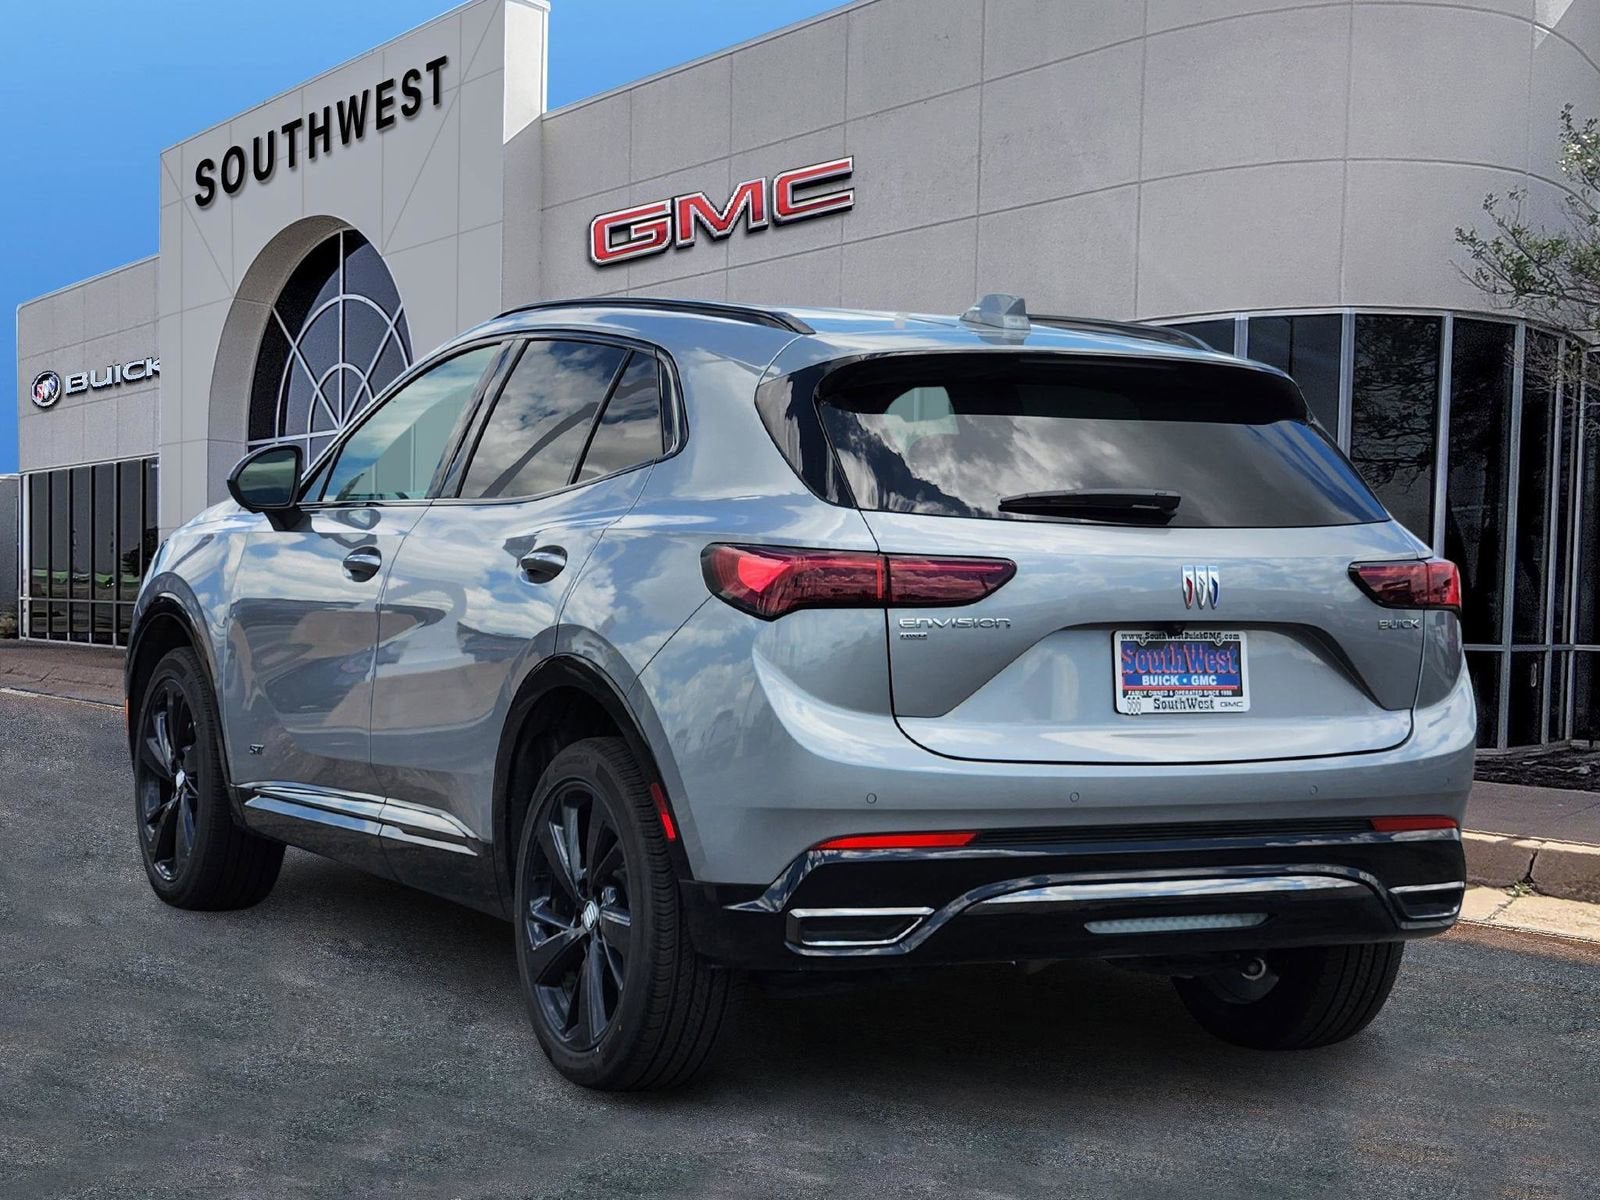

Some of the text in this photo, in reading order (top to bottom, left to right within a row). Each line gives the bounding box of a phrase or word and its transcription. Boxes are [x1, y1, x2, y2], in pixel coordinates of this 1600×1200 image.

[194, 55, 448, 207] SOUTHWEST
[588, 155, 854, 268] GMC
[65, 357, 160, 395] BUICK
[1378, 619, 1420, 630] BUICK
[1121, 642, 1239, 674] SouthWest
[1141, 675, 1217, 686] BUICK GMC
[1153, 698, 1214, 710] SouthWest
